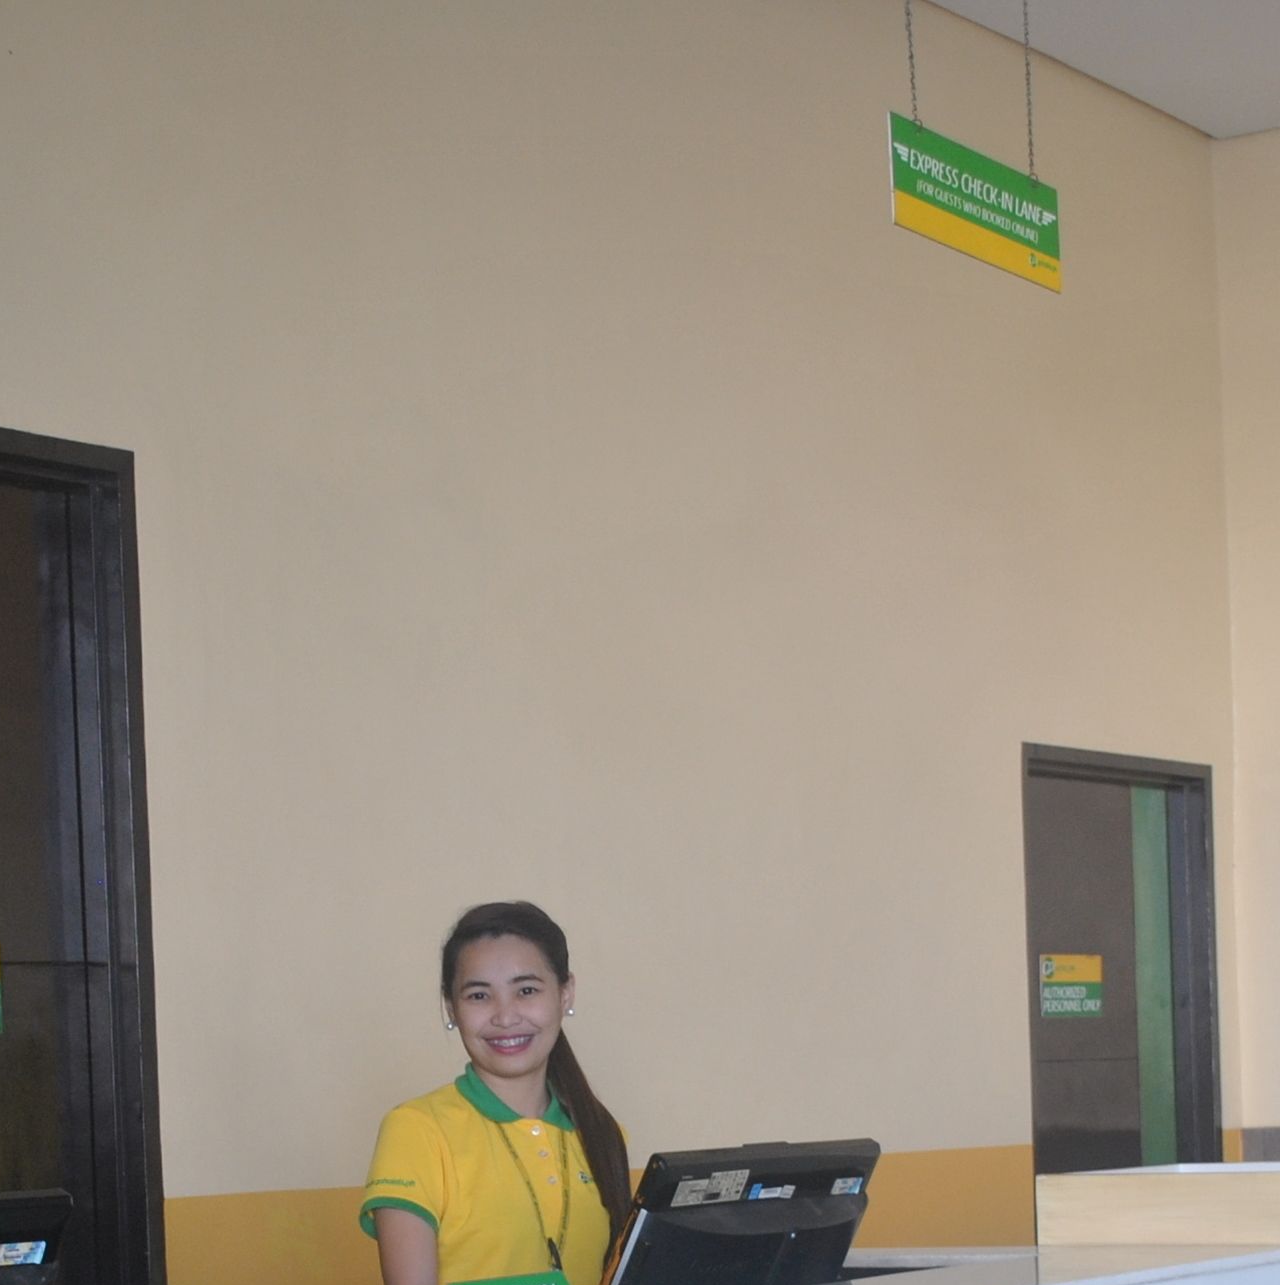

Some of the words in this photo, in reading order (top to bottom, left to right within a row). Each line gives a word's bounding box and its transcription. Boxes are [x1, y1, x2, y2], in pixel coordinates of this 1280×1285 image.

[910, 149, 959, 188] EXPRESS
[961, 174, 1014, 213] CHECK-IN
[1015, 197, 1043, 226] LANE
[934, 187, 962, 210] GUESTS
[963, 200, 981, 218] WHO
[982, 207, 1011, 231] BOOKED
[1043, 986, 1086, 998] AUTHORIZED
[1043, 999, 1081, 1012] PERSONNEL
